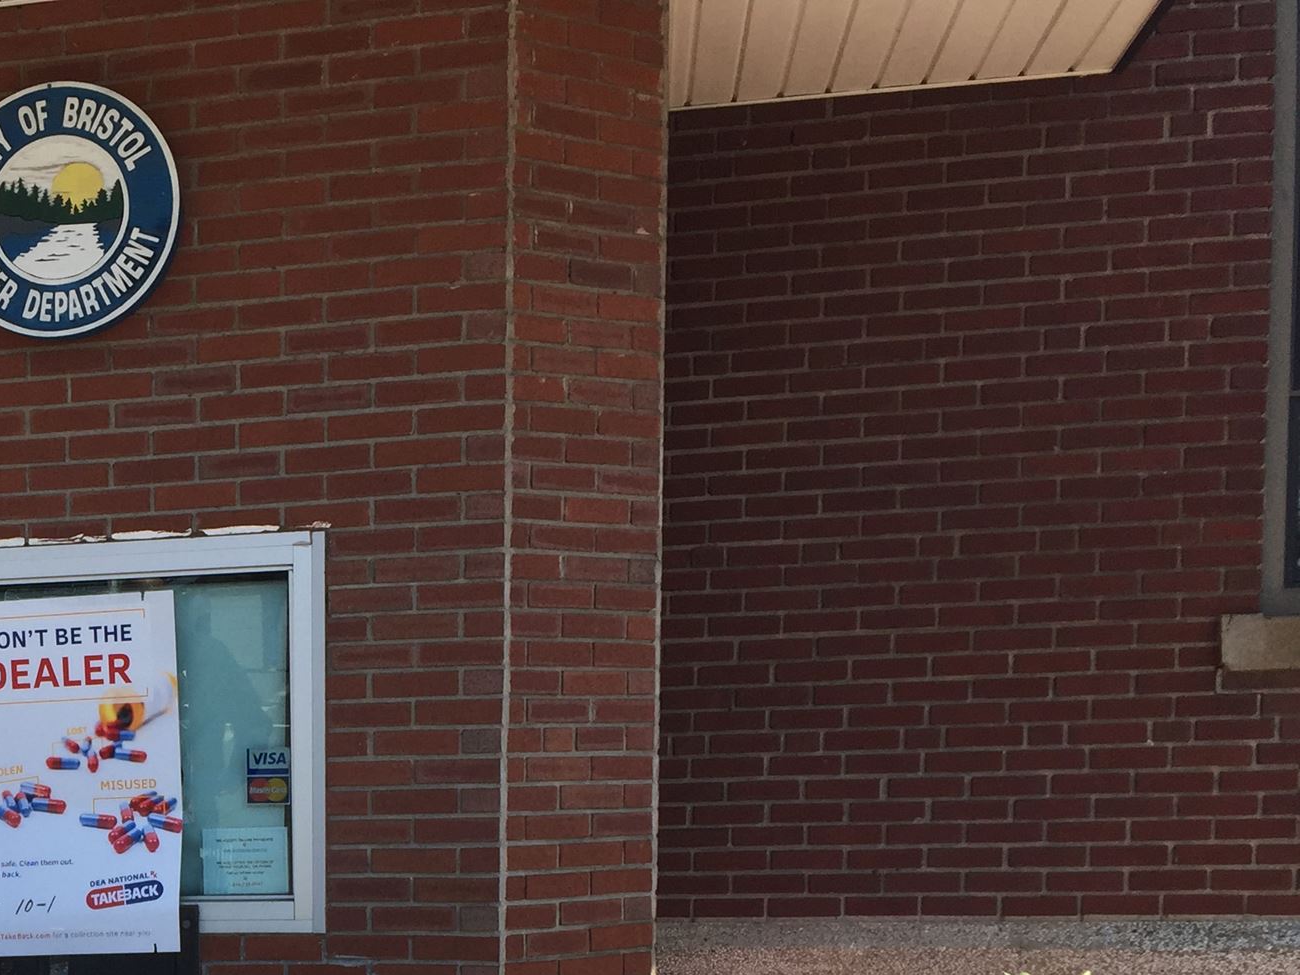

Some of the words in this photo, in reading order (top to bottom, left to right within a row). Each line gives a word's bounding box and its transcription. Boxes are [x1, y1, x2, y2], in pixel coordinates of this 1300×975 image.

[18, 100, 47, 136] OF
[62, 96, 152, 172] BRISTOL
[22, 227, 160, 322] DEPARTMENT
[55, 627, 82, 646] BE
[89, 624, 132, 643] THE
[66, 726, 87, 735] LOST
[253, 752, 286, 765] VISA
[100, 779, 157, 790] MISUSED
[19, 859, 39, 867] Clean
[1, 871, 21, 879] back.
[108, 872, 149, 884] NATIONAL
[15, 896, 57, 915] 10-1
